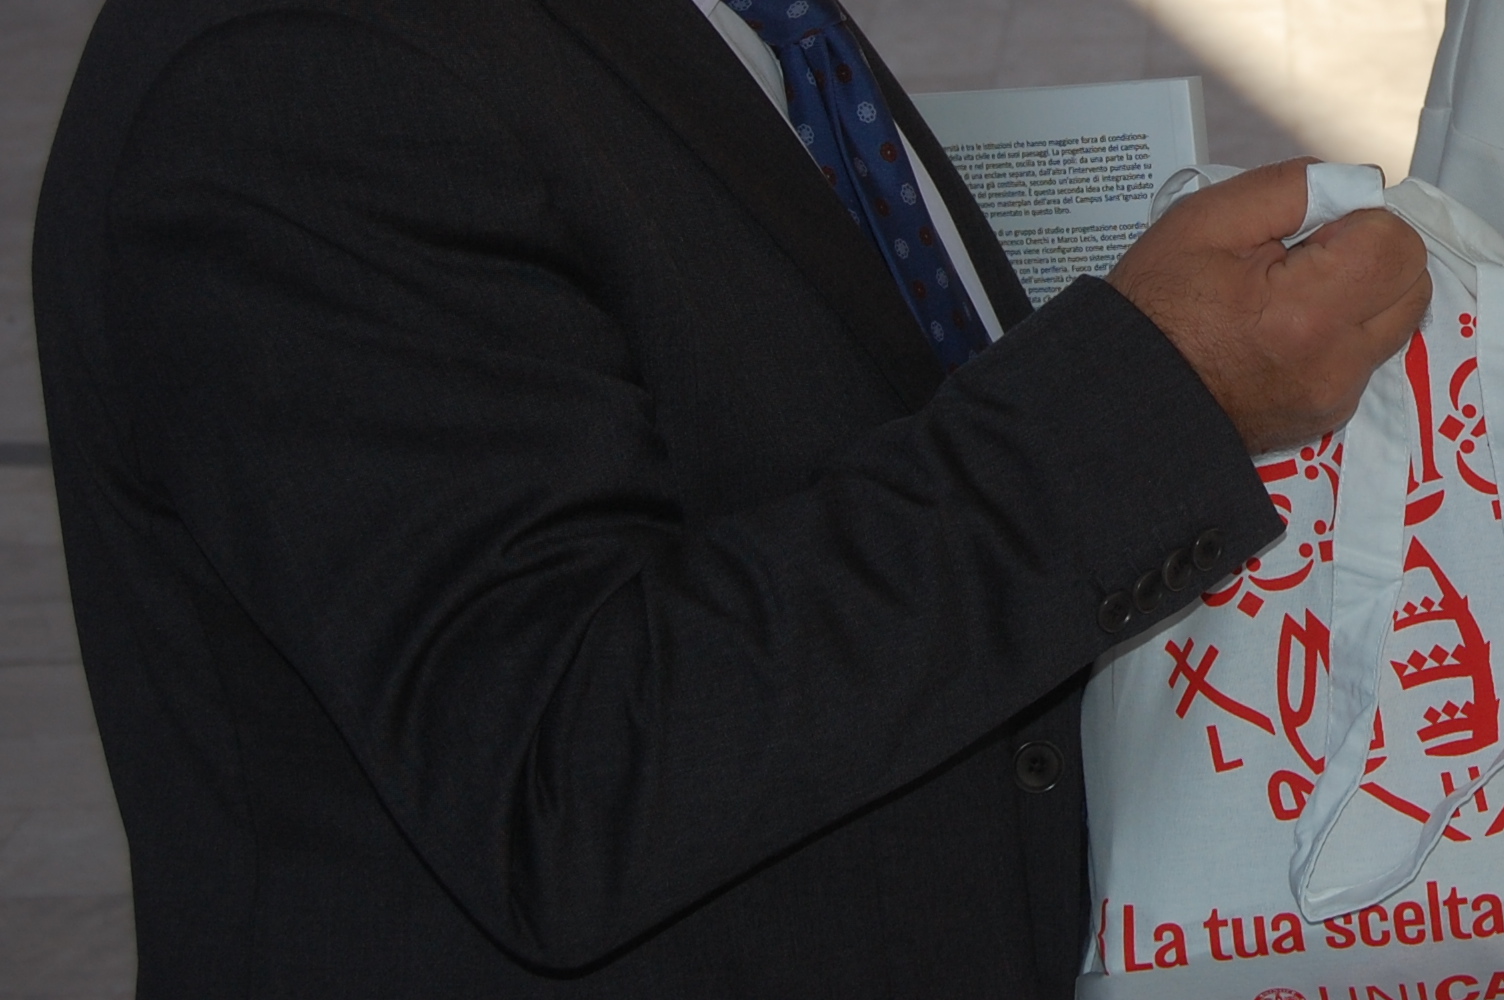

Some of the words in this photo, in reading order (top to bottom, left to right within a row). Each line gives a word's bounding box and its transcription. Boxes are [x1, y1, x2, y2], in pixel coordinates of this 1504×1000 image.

[1014, 140, 1024, 148] che
[1026, 140, 1047, 148] hanno
[1048, 137, 1079, 147] maggiore
[1081, 136, 1098, 144] forza
[1100, 135, 1106, 143] di
[1052, 148, 1059, 156] La
[1061, 145, 1106, 157] progettazione
[1120, 143, 1150, 152] campus,
[985, 160, 1014, 171] presente,
[1037, 158, 1046, 166] tra
[1048, 158, 1060, 166] due
[1079, 156, 1088, 164] da
[1105, 153, 1124, 164] parte
[1126, 153, 1132, 161] la
[1110, 162, 1141, 173] puntuale
[1029, 177, 1056, 186] secondo
[1093, 174, 1099, 182] di
[1102, 172, 1145, 183] integrazione
[1033, 187, 1055, 198] questa
[1057, 186, 1084, 195] seconda
[1102, 184, 1114, 192] che
[1116, 183, 1124, 191] ha
[1126, 181, 1154, 192] guidato
[1075, 195, 1102, 204] Campus
[1031, 207, 1053, 217] questo
[1054, 206, 1071, 214] libro.
[1014, 229, 1036, 238] gruppo
[1037, 227, 1043, 235] di
[1044, 226, 1064, 234] studio
[1071, 223, 1117, 235] progettazione
[1057, 235, 1078, 243] Marco
[1089, 252, 1115, 261] sistema
[1033, 266, 1038, 274] la
[1202, 908, 1306, 962] tua
